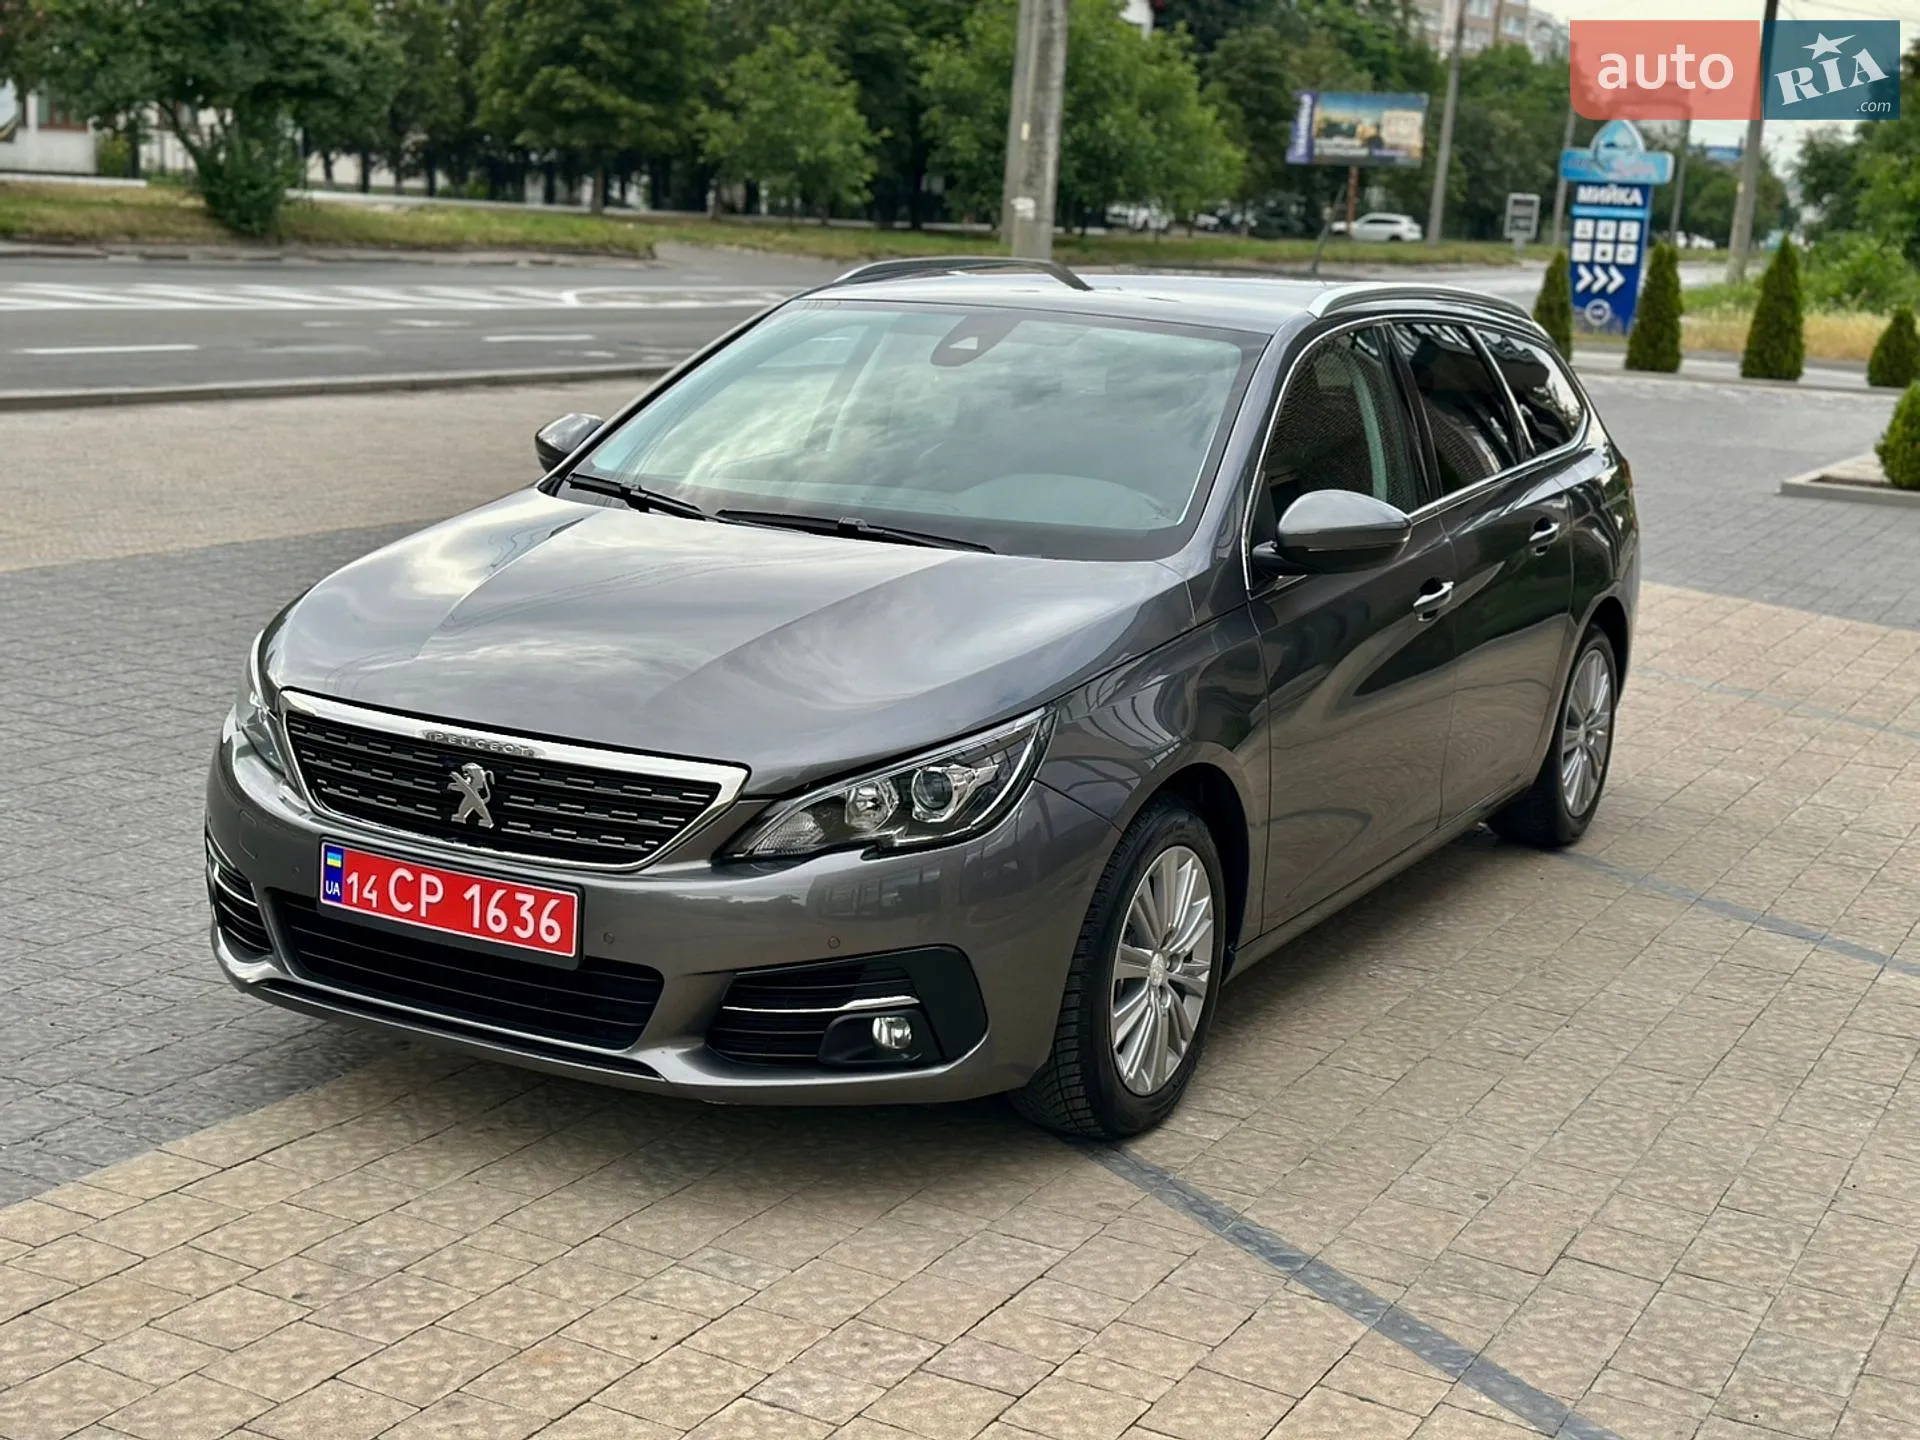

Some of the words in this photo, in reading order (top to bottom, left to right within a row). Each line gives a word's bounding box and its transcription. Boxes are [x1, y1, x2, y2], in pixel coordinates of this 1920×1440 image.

[1576, 184, 1644, 206] МИЙКА
[433, 731, 530, 757] PEUGEOT
[325, 880, 341, 897] UA
[346, 871, 378, 909] 14
[388, 867, 444, 918] CP
[463, 883, 562, 944] 1636
